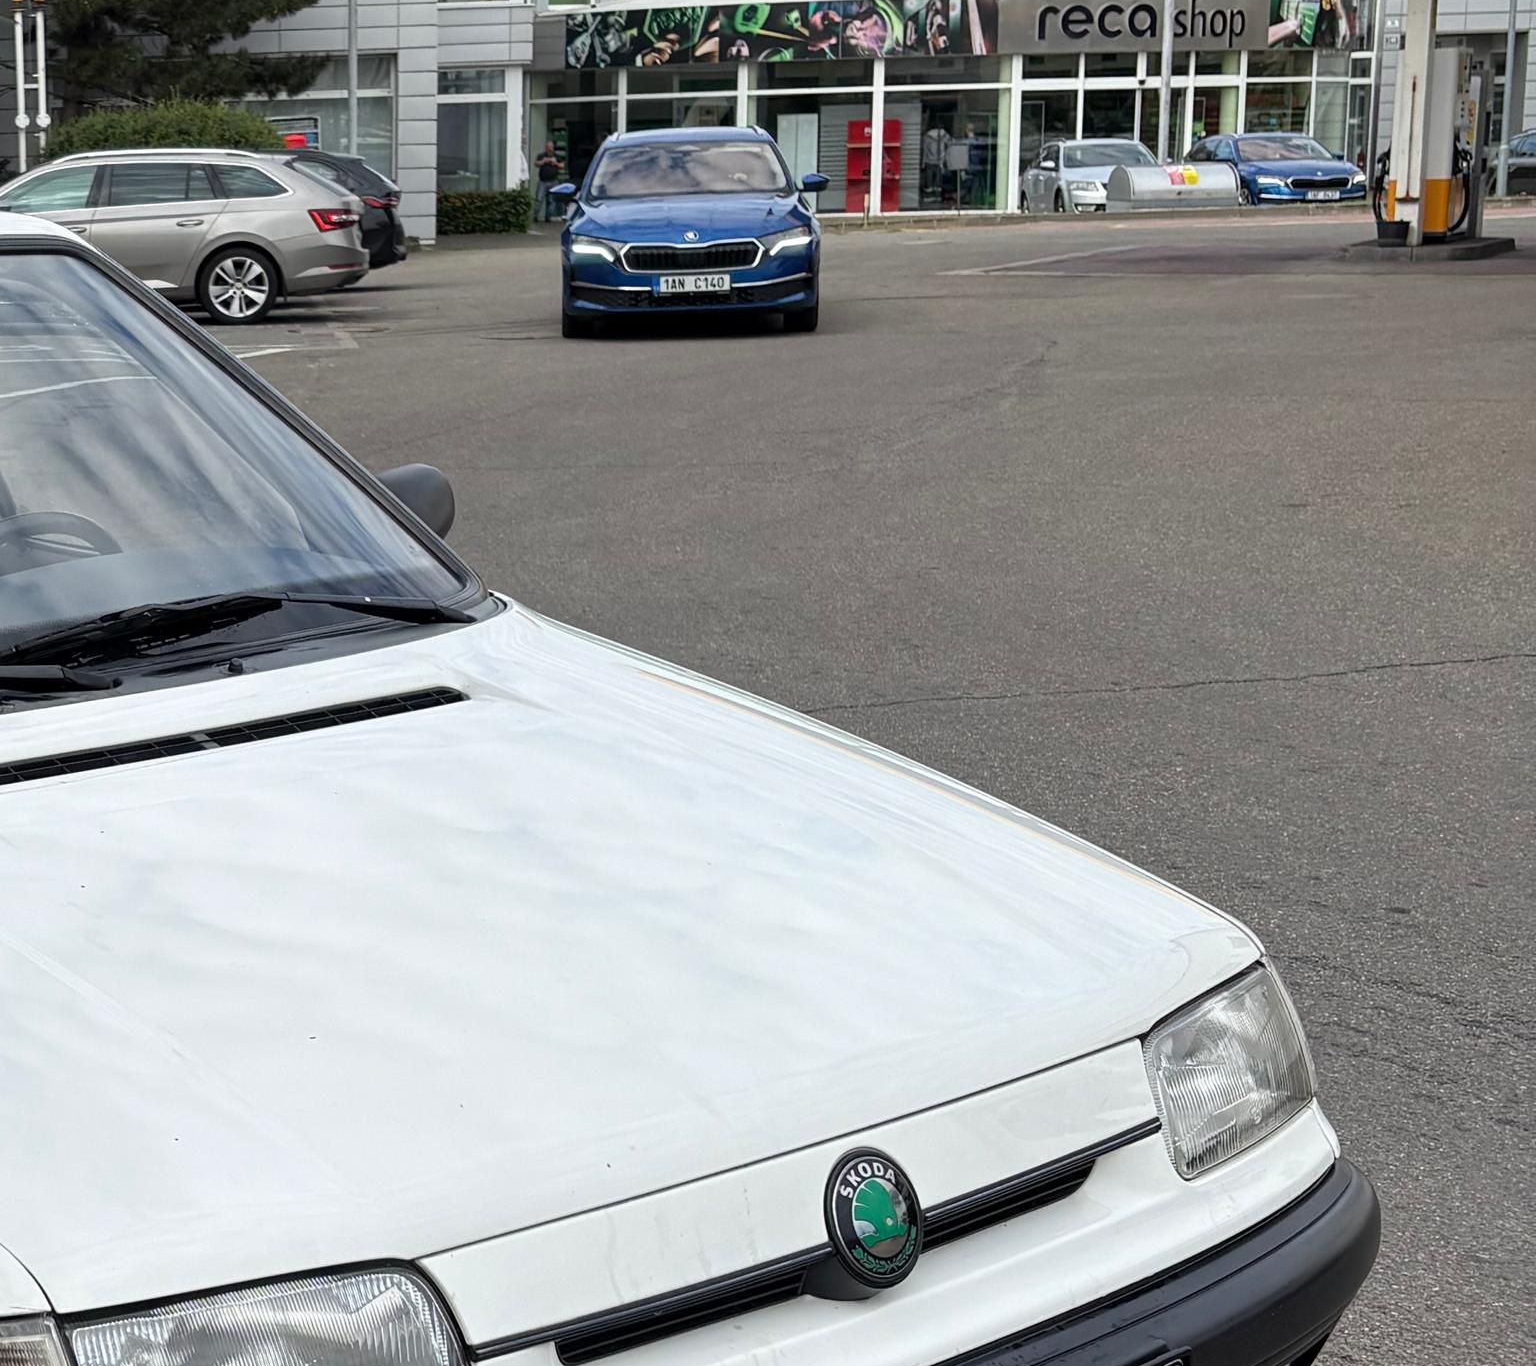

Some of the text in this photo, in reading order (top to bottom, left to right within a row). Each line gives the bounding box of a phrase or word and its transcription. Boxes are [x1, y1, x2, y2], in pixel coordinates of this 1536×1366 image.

[1037, 3, 1158, 41] reca
[663, 277, 686, 291] 1AN
[694, 275, 725, 290] C140
